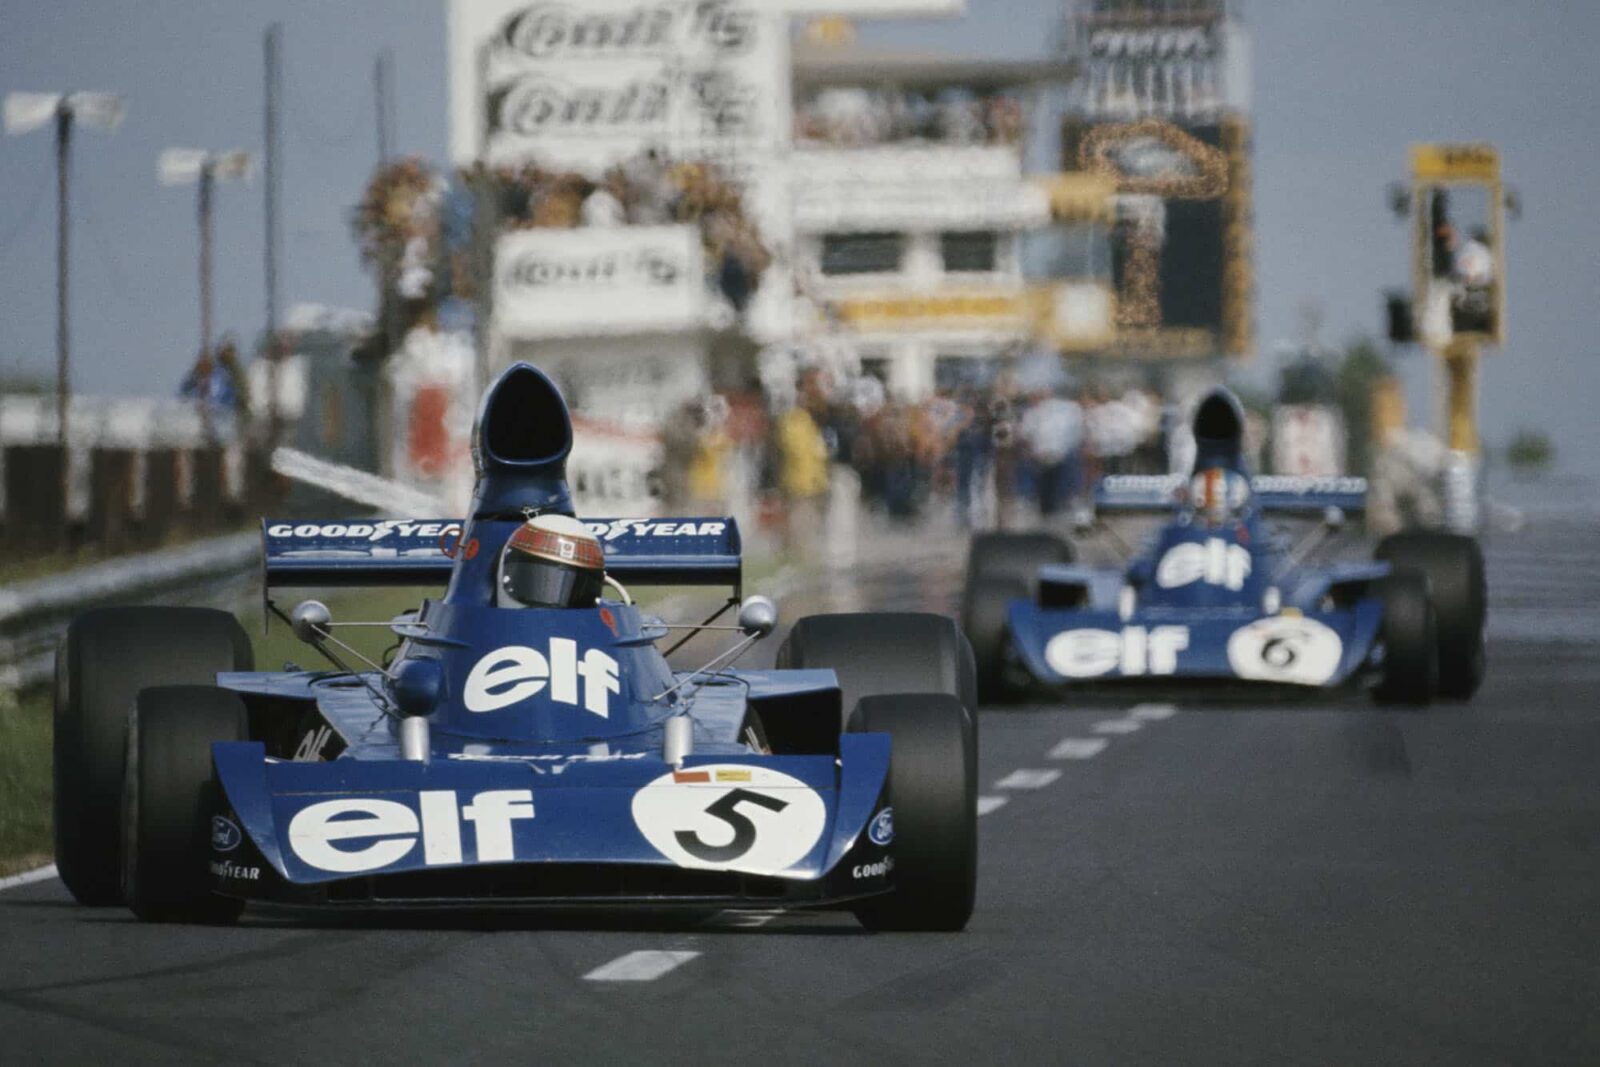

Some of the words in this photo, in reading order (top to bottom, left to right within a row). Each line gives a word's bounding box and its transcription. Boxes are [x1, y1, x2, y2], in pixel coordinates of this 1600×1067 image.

[268, 519, 462, 541] GOODYEA
[584, 519, 726, 541] DYEAR
[1156, 537, 1252, 592] elf
[463, 637, 620, 718] elf
[288, 789, 535, 873] elf
[674, 787, 790, 863] 5
[852, 855, 894, 879] GOOD
